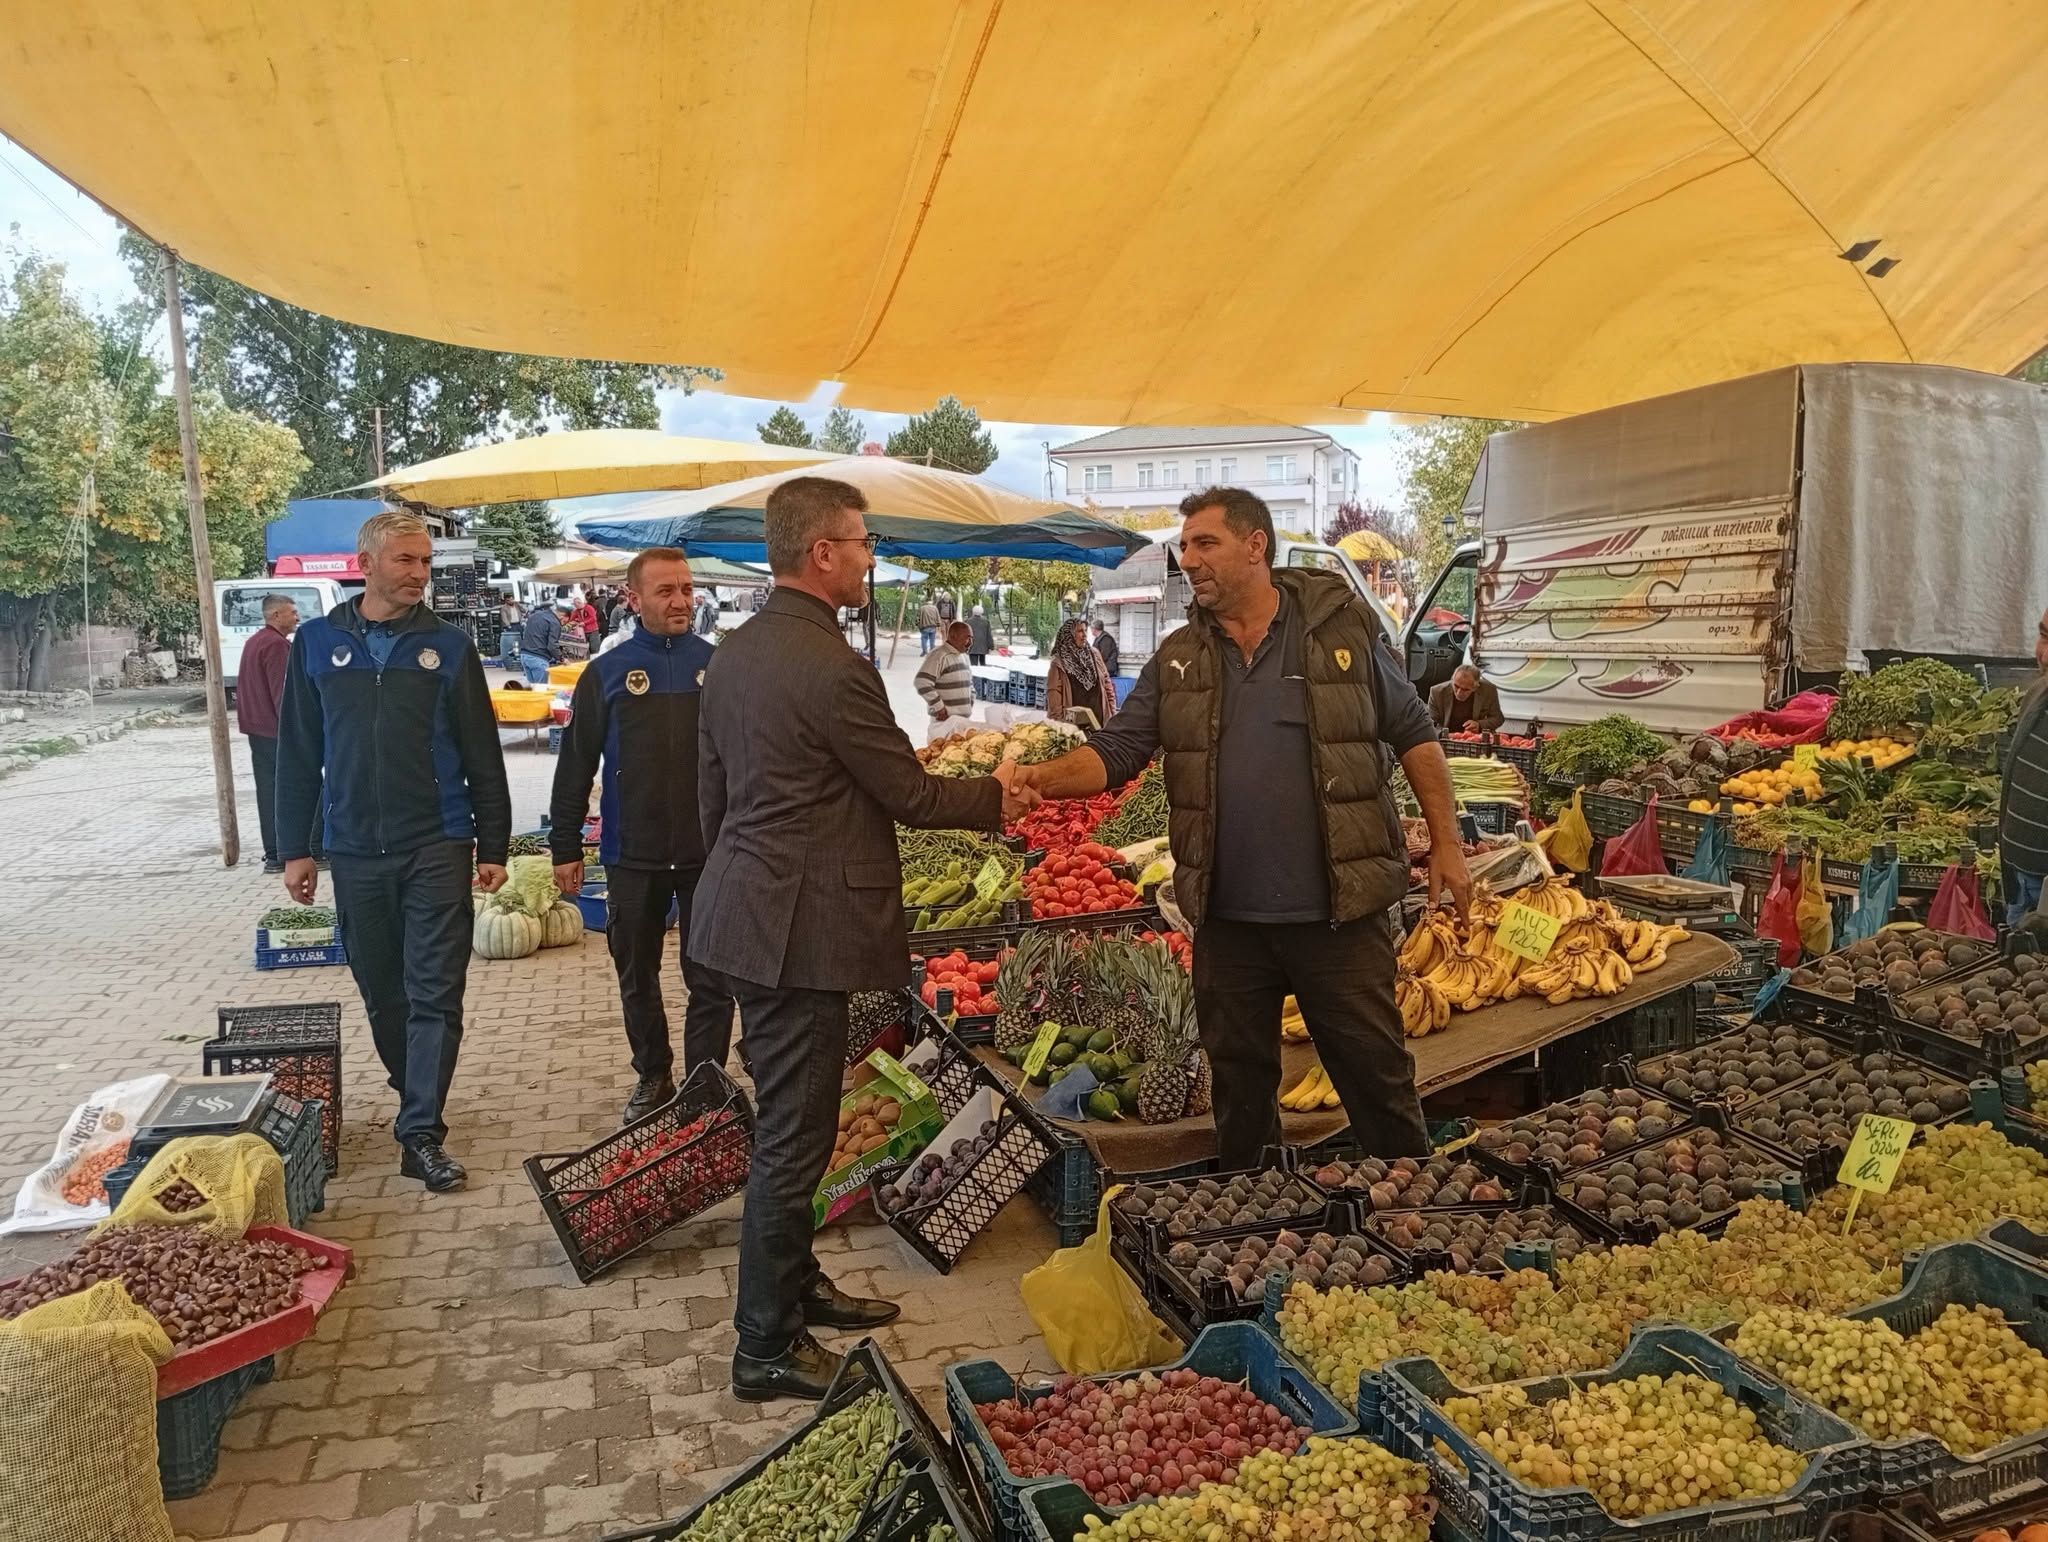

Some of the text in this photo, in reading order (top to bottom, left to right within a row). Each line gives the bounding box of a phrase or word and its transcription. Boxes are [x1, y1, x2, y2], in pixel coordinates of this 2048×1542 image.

[1661, 526, 1711, 543] DOĞRULUK
[1708, 625, 1741, 637] Turbo
[1827, 867, 1851, 880] KISMET
